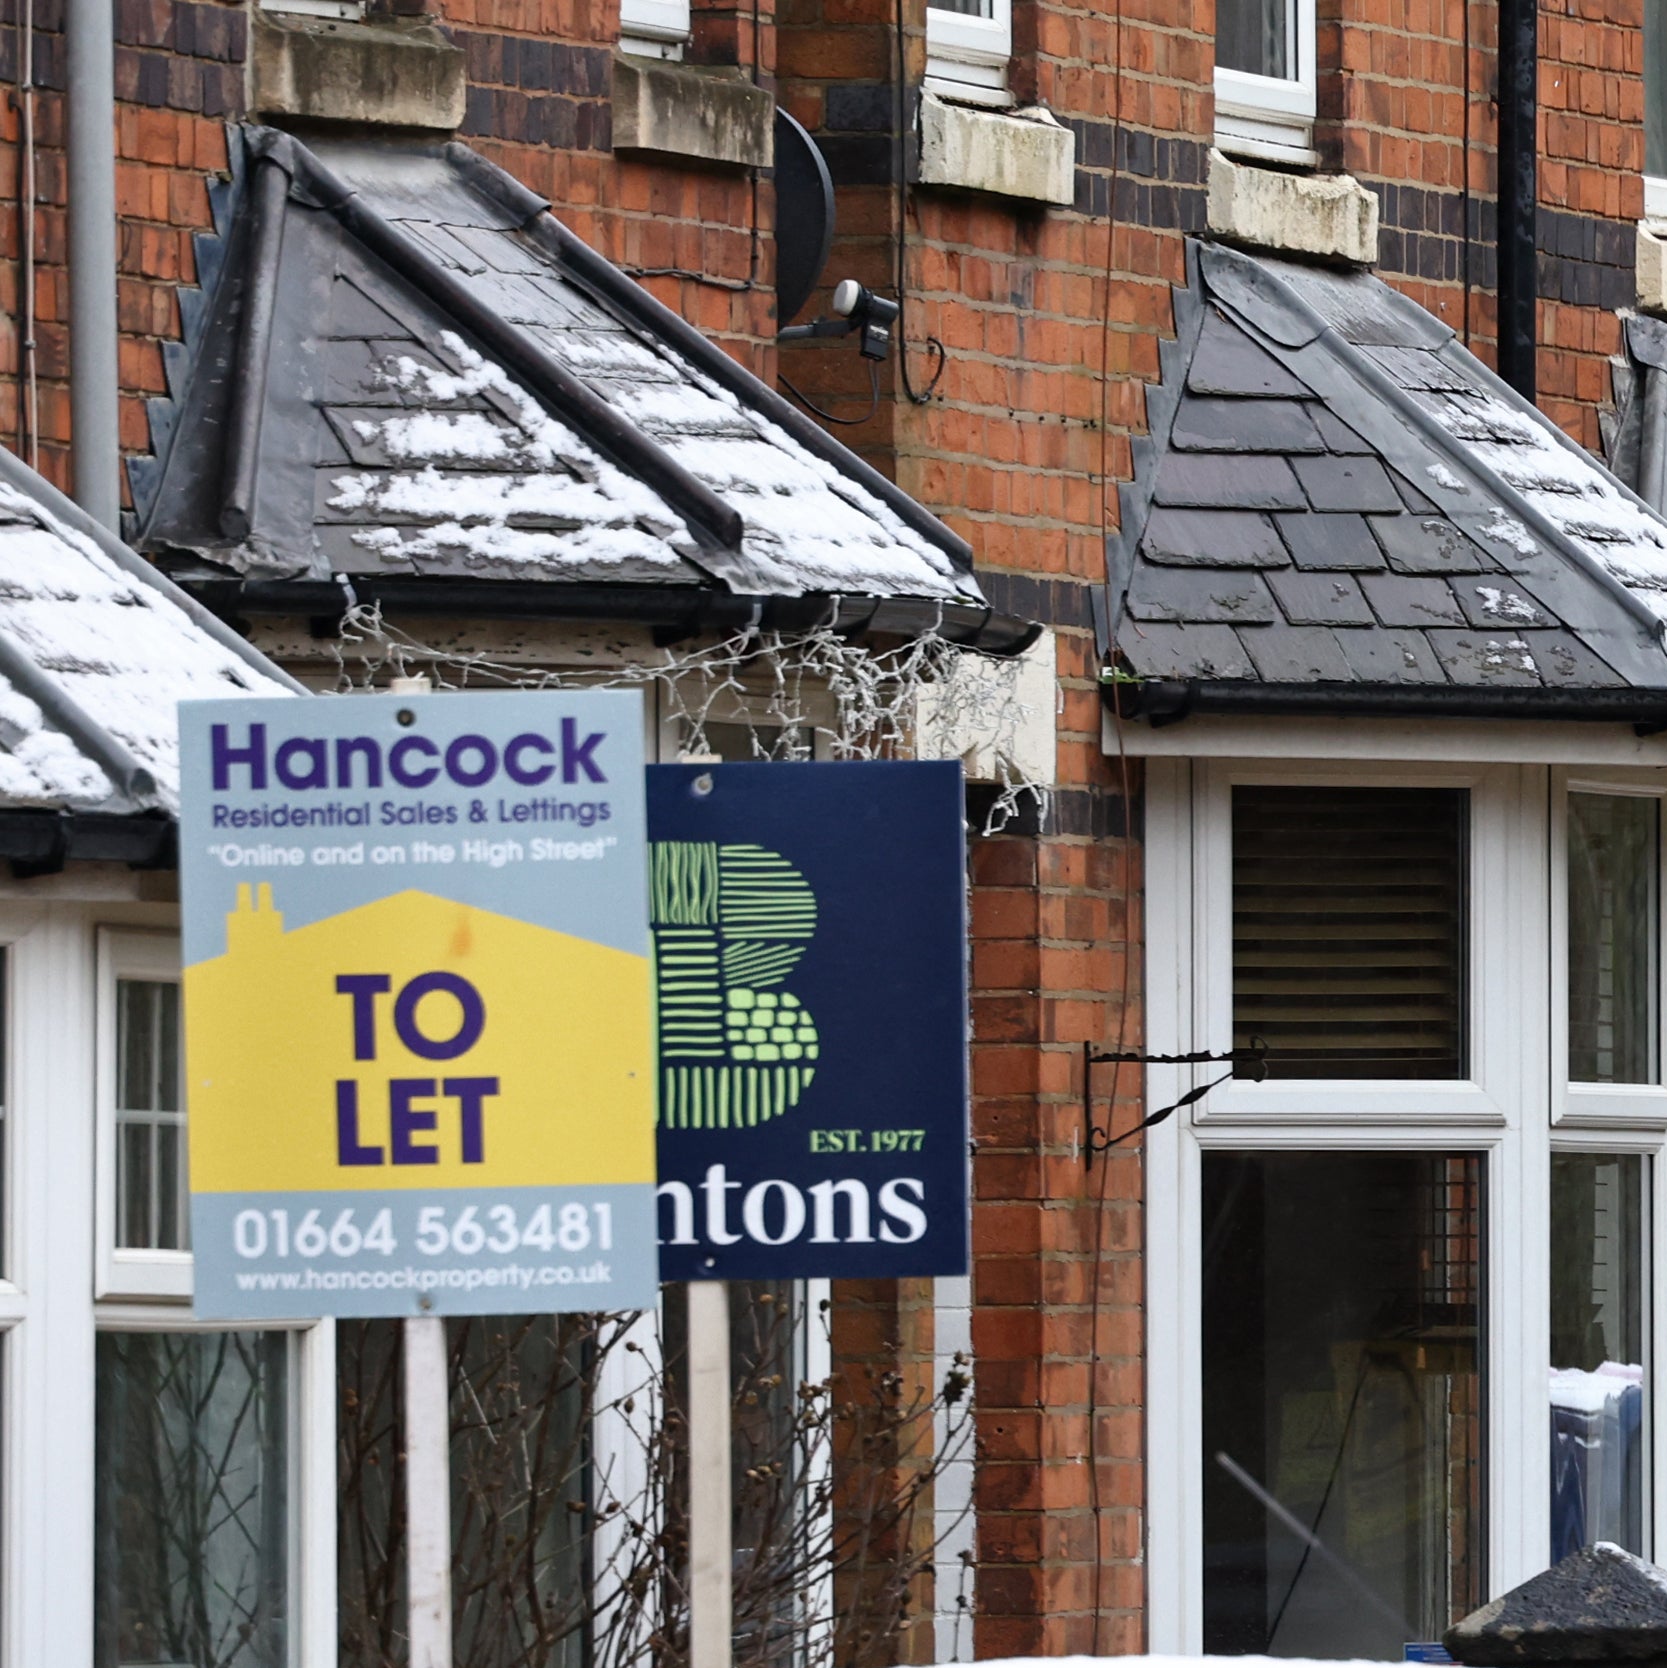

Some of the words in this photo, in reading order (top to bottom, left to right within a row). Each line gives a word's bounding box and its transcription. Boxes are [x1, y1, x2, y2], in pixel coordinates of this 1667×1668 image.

[210, 717, 608, 790] Hancock
[213, 801, 371, 829] Residential
[380, 800, 458, 827] Sales
[468, 801, 488, 823] &
[500, 798, 611, 827] Lettings
[312, 842, 363, 866] and
[370, 846, 406, 866] on
[412, 840, 456, 864] the
[462, 838, 524, 868] High
[335, 970, 486, 1061] TO
[335, 1076, 500, 1167] LET
[809, 1129, 867, 1153] EST.
[871, 1129, 926, 1152] 1977
[233, 1207, 398, 1258] 01664
[415, 1203, 613, 1256] 563481
[236, 1261, 612, 1291] www.hancockproperty.co.uk
